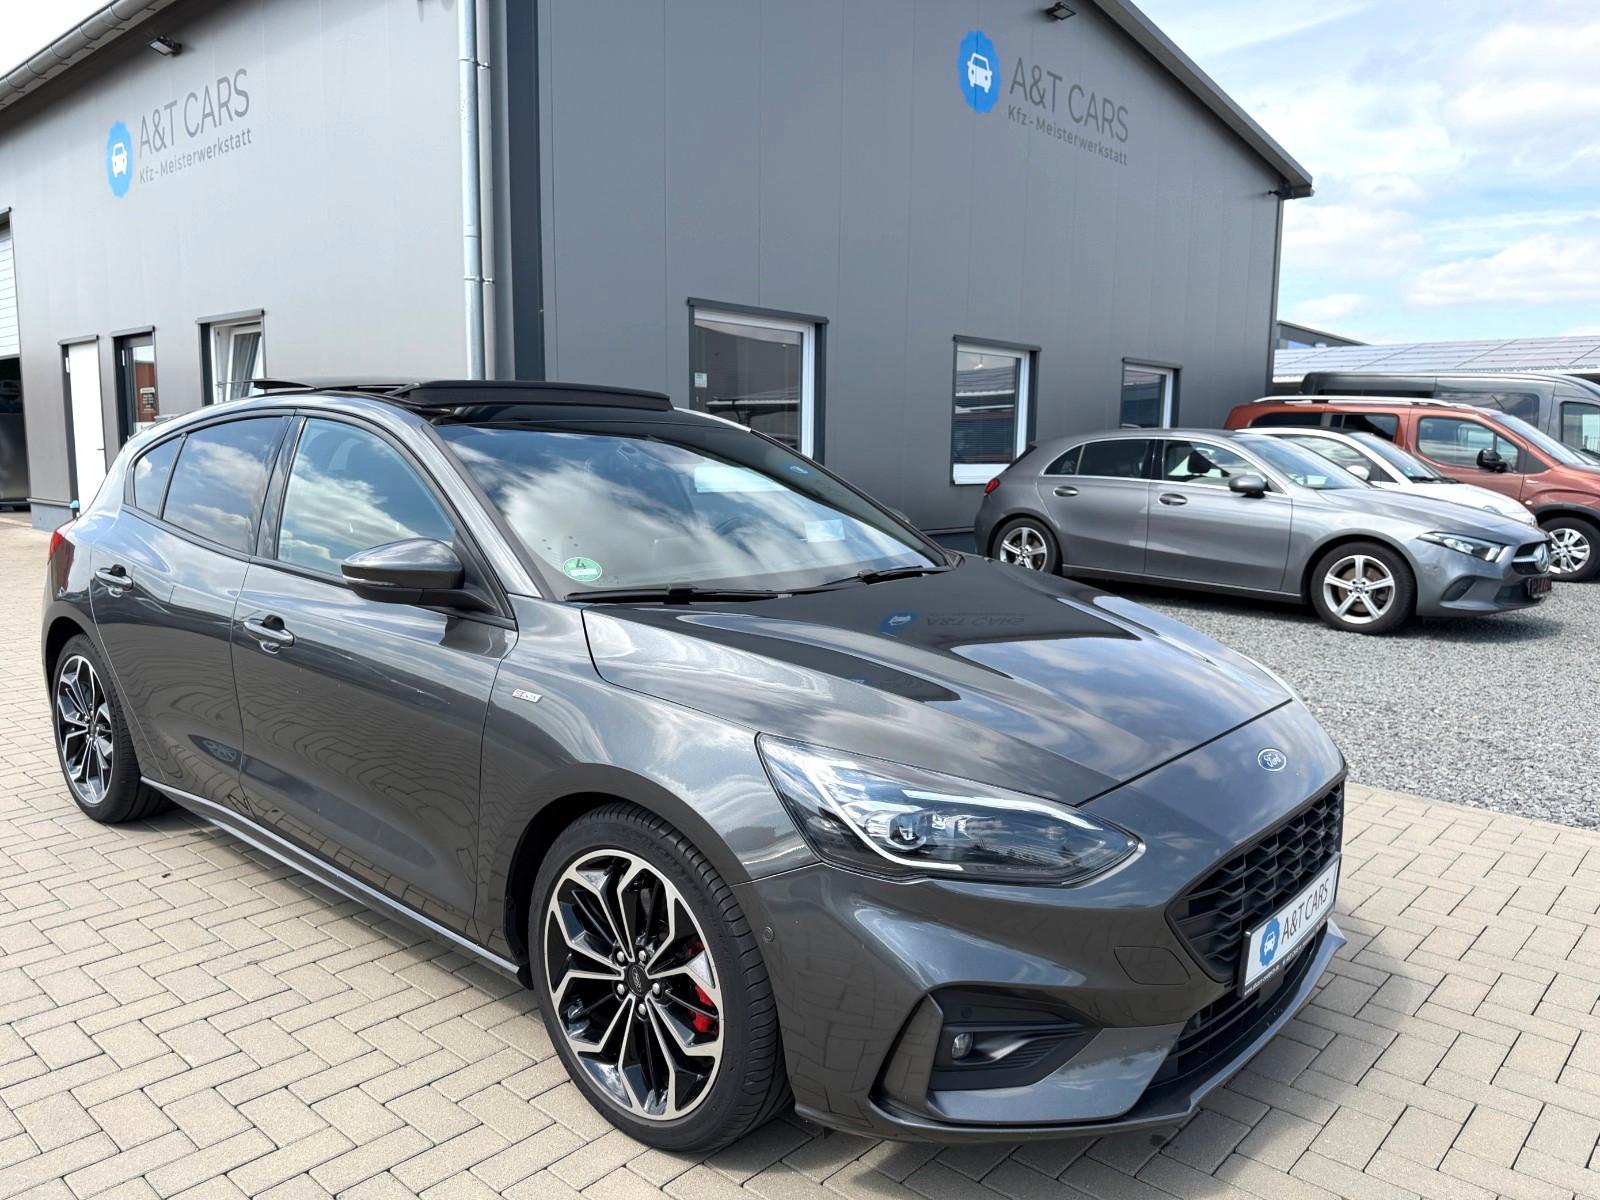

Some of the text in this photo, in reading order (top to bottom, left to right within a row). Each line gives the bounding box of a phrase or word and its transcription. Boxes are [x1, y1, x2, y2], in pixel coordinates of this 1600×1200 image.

[139, 68, 250, 160] A&T CARS
[1009, 57, 1129, 143] A&T CARS
[576, 559, 587, 570] 4
[1281, 878, 1329, 944] A&T CARS
